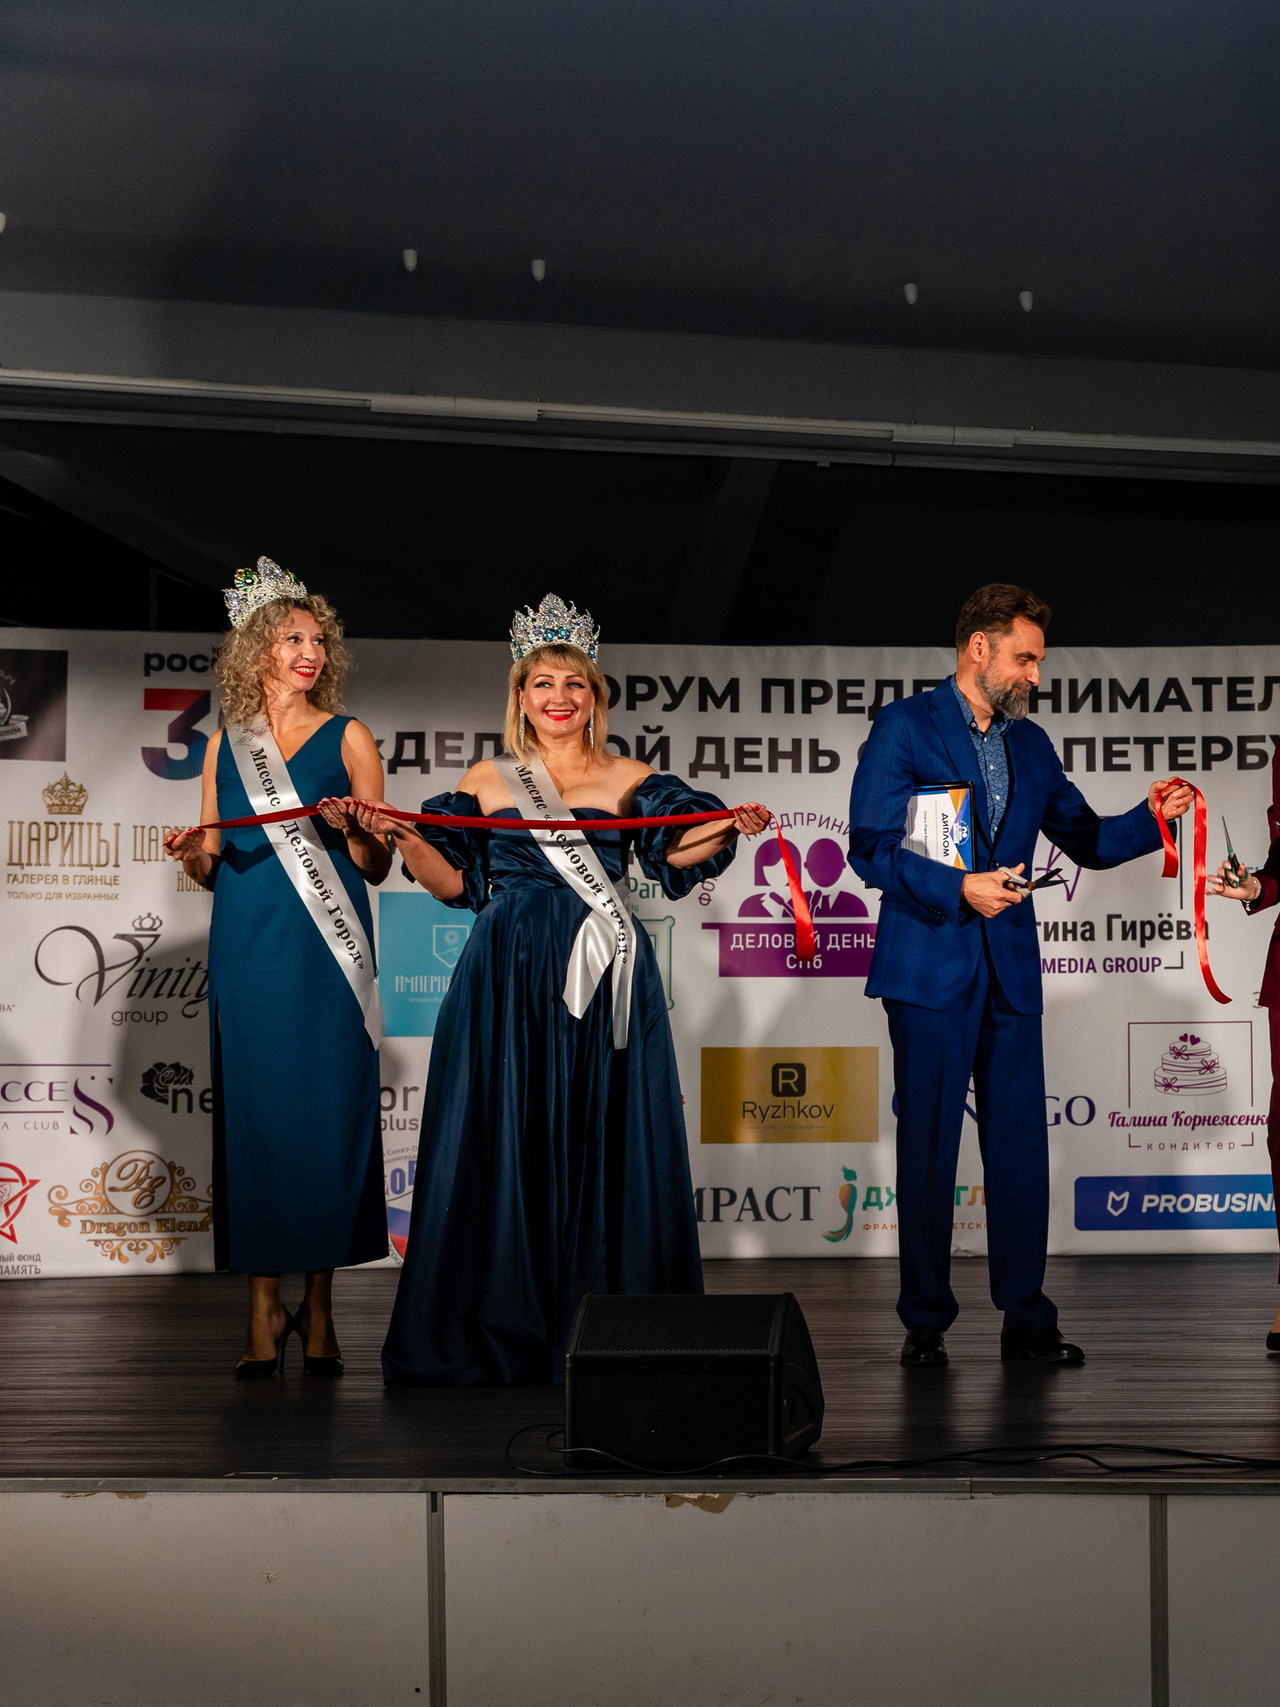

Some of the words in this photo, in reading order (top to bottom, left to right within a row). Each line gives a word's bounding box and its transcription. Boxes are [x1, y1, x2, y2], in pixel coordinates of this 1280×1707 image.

[144, 652, 217, 677] рос
[688, 735, 841, 780] ДЕНЬ
[514, 764, 549, 811] Миссис
[6, 820, 121, 869] ЦАРИЦЫ
[941, 812, 950, 857] ДИПЛОМ
[249, 746, 281, 807] Миссис
[279, 820, 334, 903] Деловой
[327, 904, 365, 970] Город»
[6, 873, 59, 885] ГАЛЕРЕЯ
[62, 874, 70, 885] В
[73, 875, 120, 887] ГЛЯНЦЕ
[7, 891, 43, 900] ТОЛЬКО
[45, 892, 64, 901] ДЛЯ
[66, 892, 120, 901] ИЗБРАННЫХ
[730, 930, 821, 951] ДЕЛОВЙ
[826, 933, 875, 951] ДЕНЬ
[1036, 920, 1096, 942] ина
[1042, 957, 1097, 974] MEDIA
[1103, 957, 1162, 973] GROUP
[111, 1010, 168, 1027] group
[777, 1067, 799, 1092] R
[742, 1101, 835, 1124] Ryzhkov
[1108, 1111, 1167, 1128] Галина
[23, 1121, 60, 1131] CLUB
[1147, 1141, 1237, 1151] кондитер
[695, 1186, 821, 1223] PACT
[79, 1218, 151, 1235] Dragon
[155, 1217, 211, 1234] Elena
[17, 1253, 41, 1263] ФОНД
